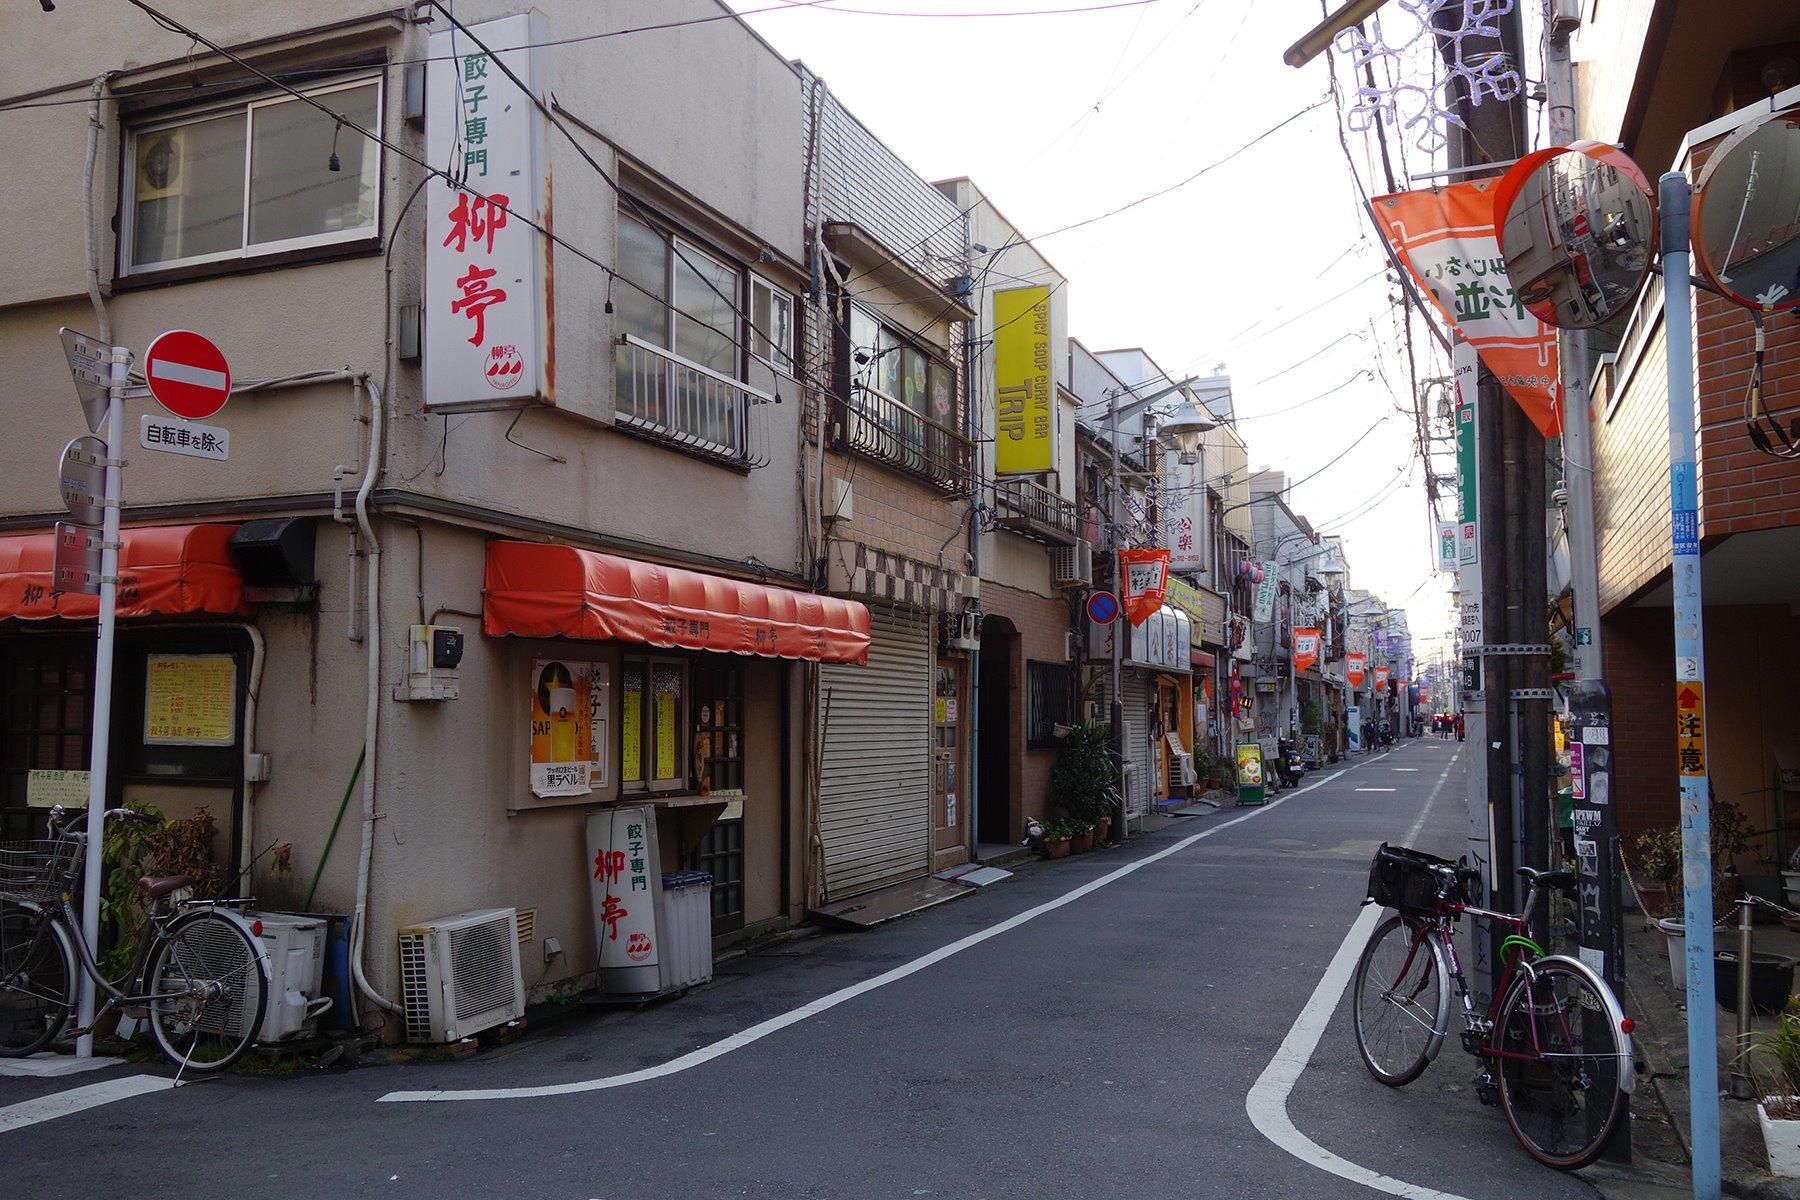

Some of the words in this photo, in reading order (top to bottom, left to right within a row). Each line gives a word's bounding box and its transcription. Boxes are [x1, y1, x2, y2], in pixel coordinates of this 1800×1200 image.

[463, 52, 488, 177] 餃子専門
[443, 193, 510, 347] 柳亭
[1033, 304, 1047, 337] SPICY
[1034, 343, 1048, 371] SOUP
[998, 377, 1034, 441] TRIP
[1034, 376, 1049, 410] CURRY
[147, 423, 225, 453] 自転車を除く
[1034, 416, 1049, 440] BAR
[1679, 713, 1705, 774] 注意
[547, 773, 579, 788] 黒ラベル
[626, 823, 647, 892] 餃子専門
[594, 848, 628, 941] 柳亭
